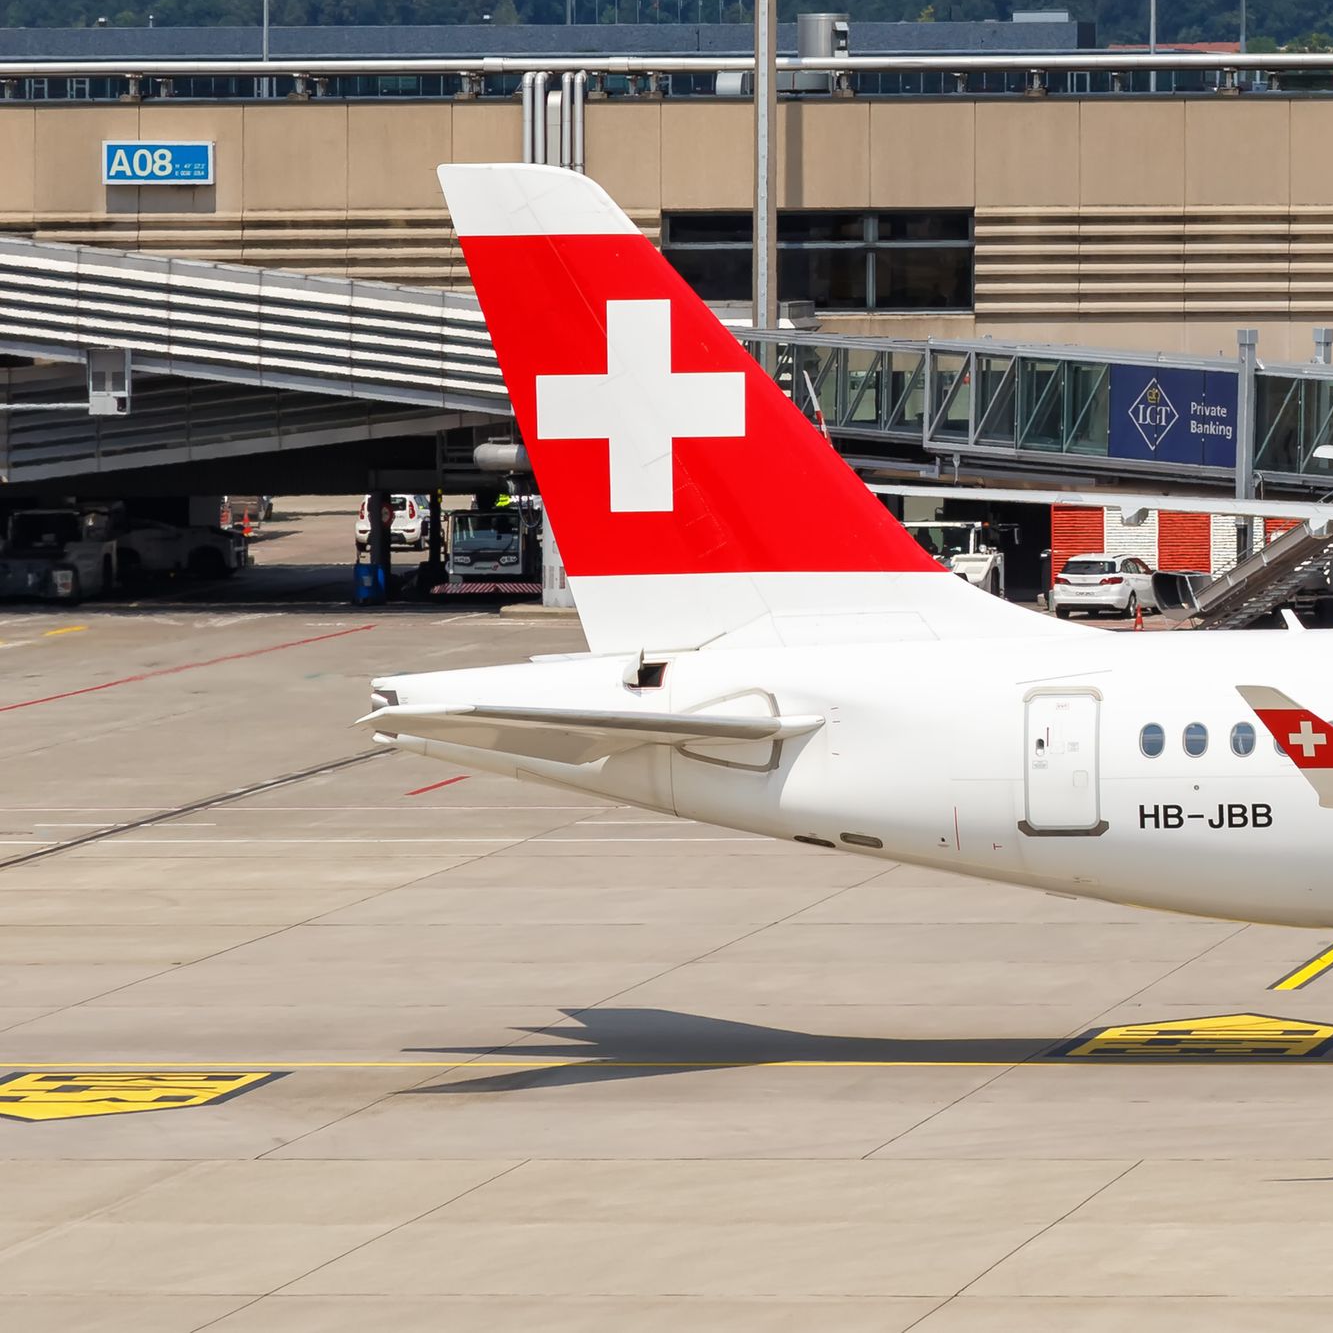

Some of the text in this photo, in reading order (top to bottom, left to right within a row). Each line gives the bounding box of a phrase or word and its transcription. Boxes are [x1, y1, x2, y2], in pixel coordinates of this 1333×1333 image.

[109, 148, 173, 177] A08
[1138, 404, 1170, 426] LGT
[1190, 401, 1227, 418] Private
[1190, 420, 1232, 440] Banking
[1139, 803, 1273, 829] HB-JBB
